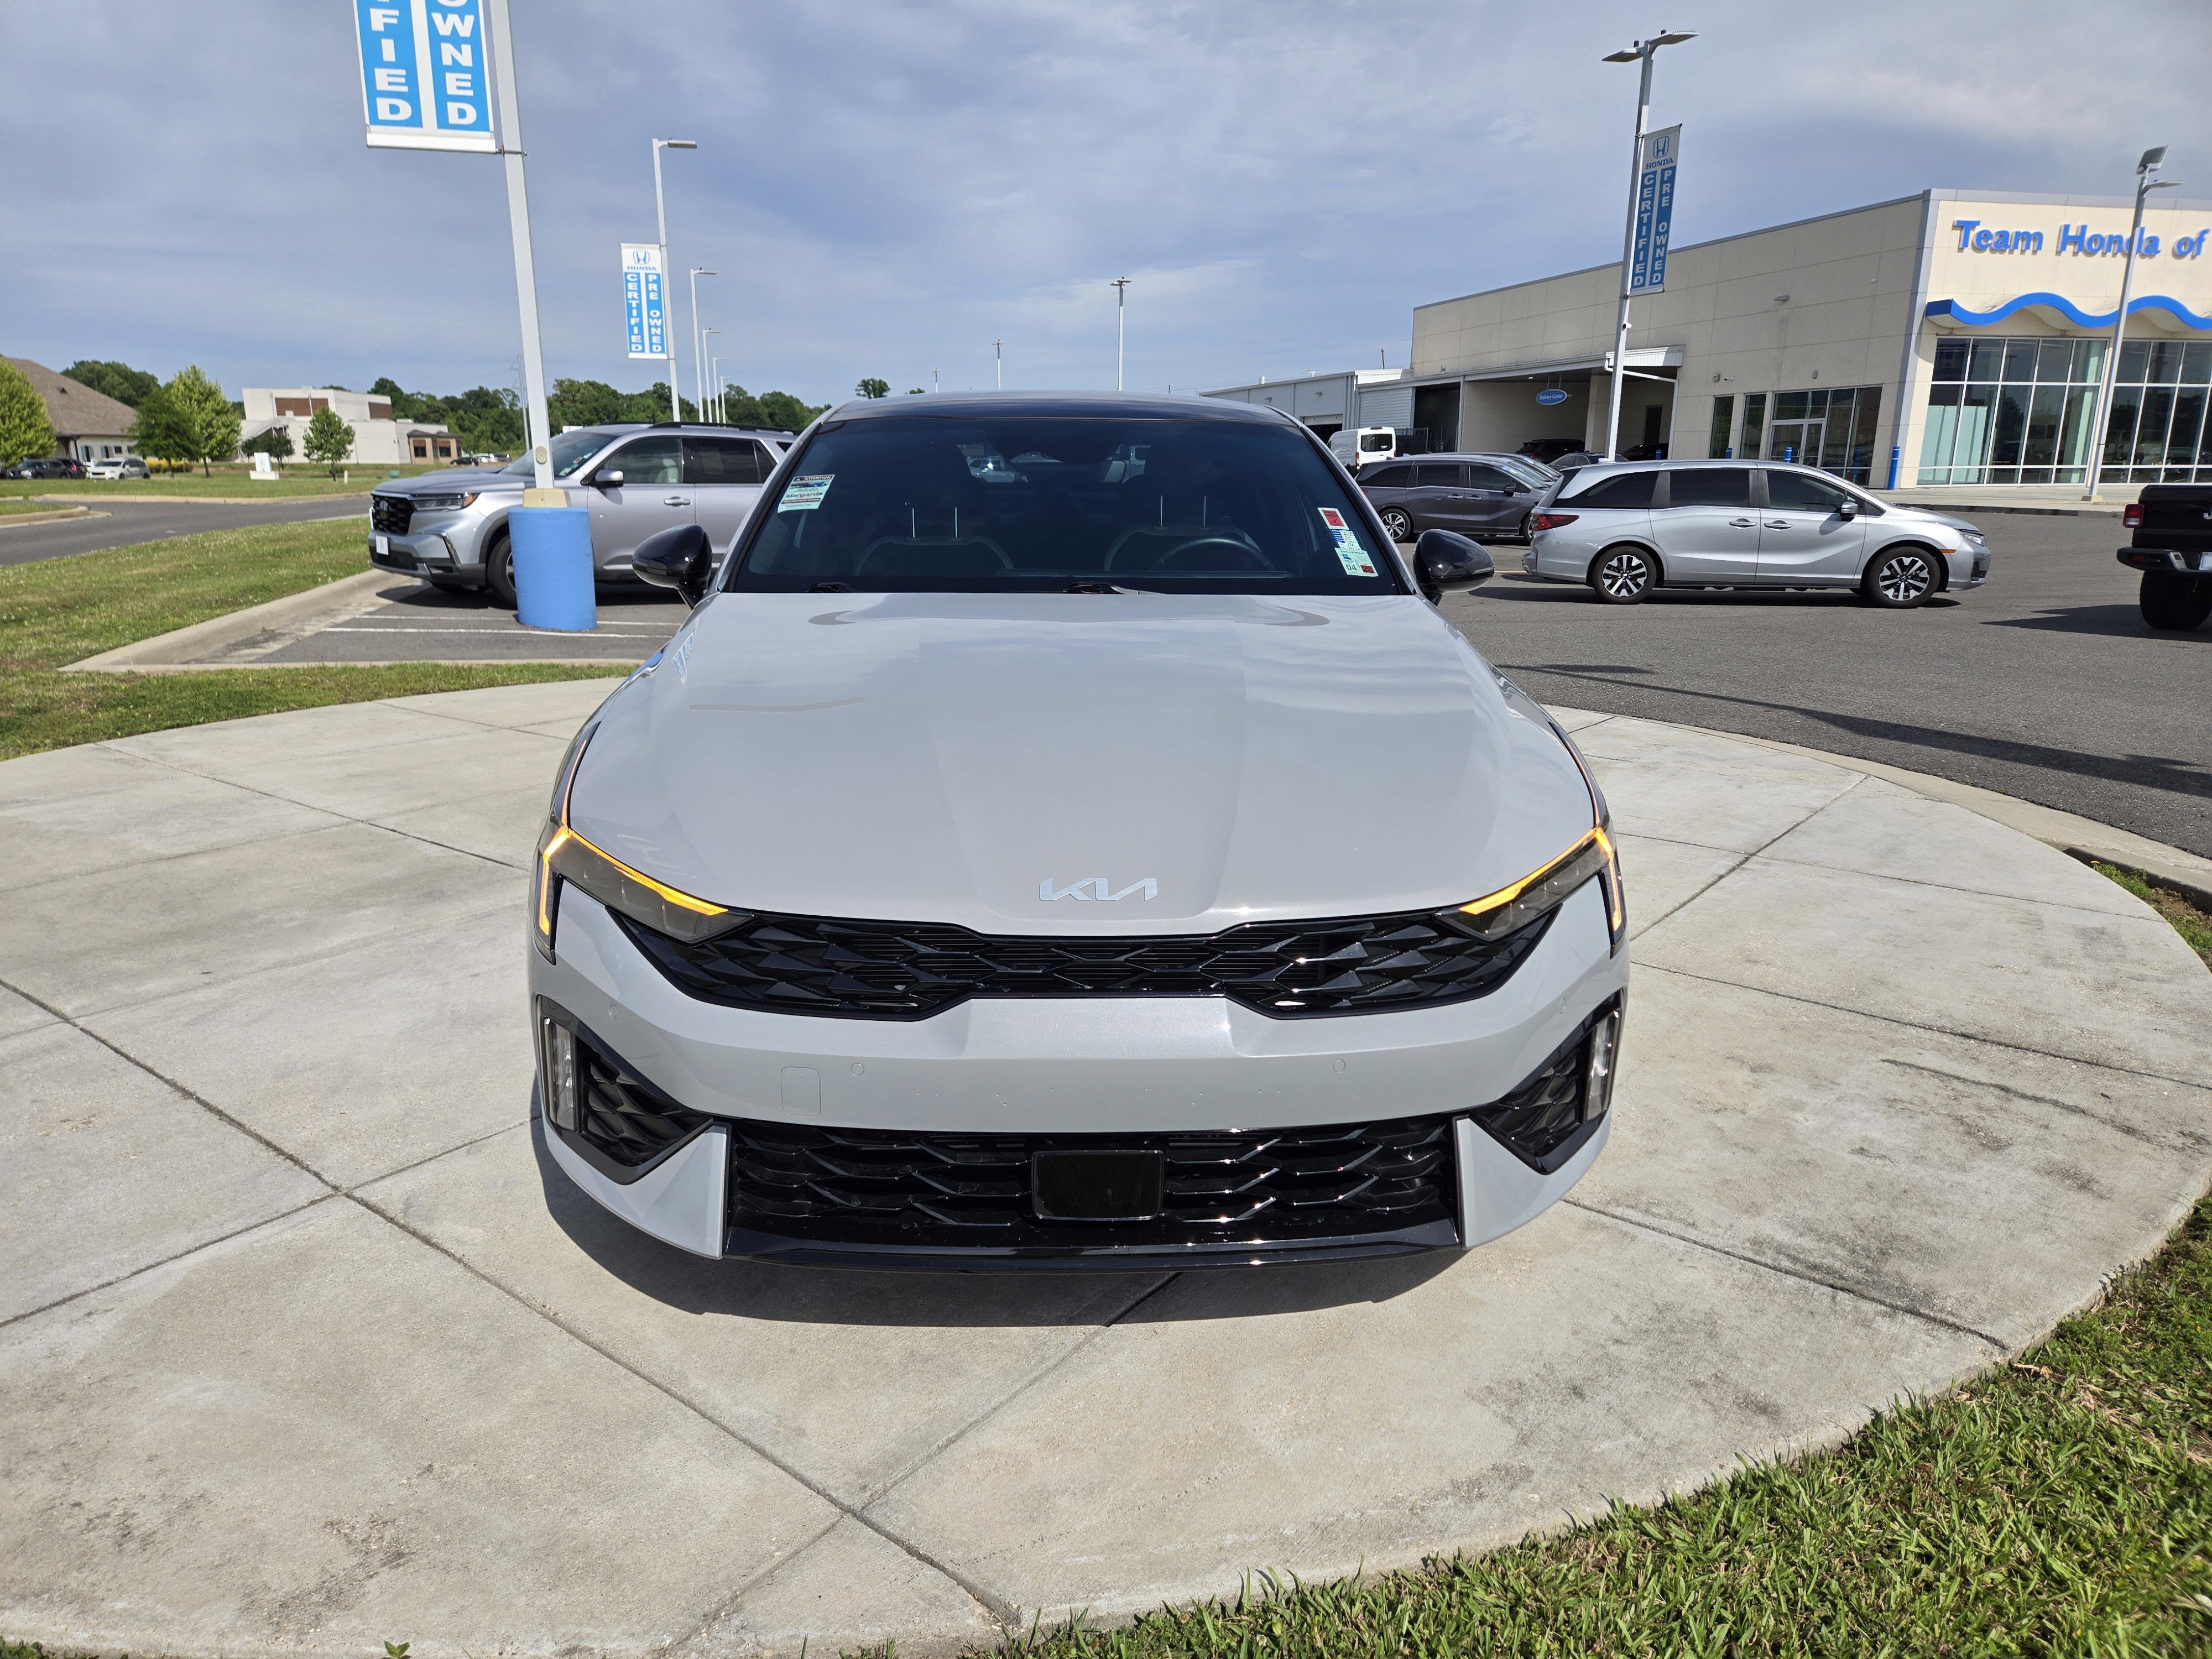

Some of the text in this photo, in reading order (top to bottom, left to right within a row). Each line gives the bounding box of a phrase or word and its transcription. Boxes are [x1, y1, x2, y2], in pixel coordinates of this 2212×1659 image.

[369, 0, 412, 121] FIED
[1645, 158, 1673, 170] HONDA
[1634, 174, 1654, 286] CERTIFIED
[1652, 169, 1672, 284] PRE OWNED
[1953, 220, 2210, 257] Team Honda of
[626, 273, 643, 352] CERTIFIED
[648, 274, 662, 352] PRE OWNED
